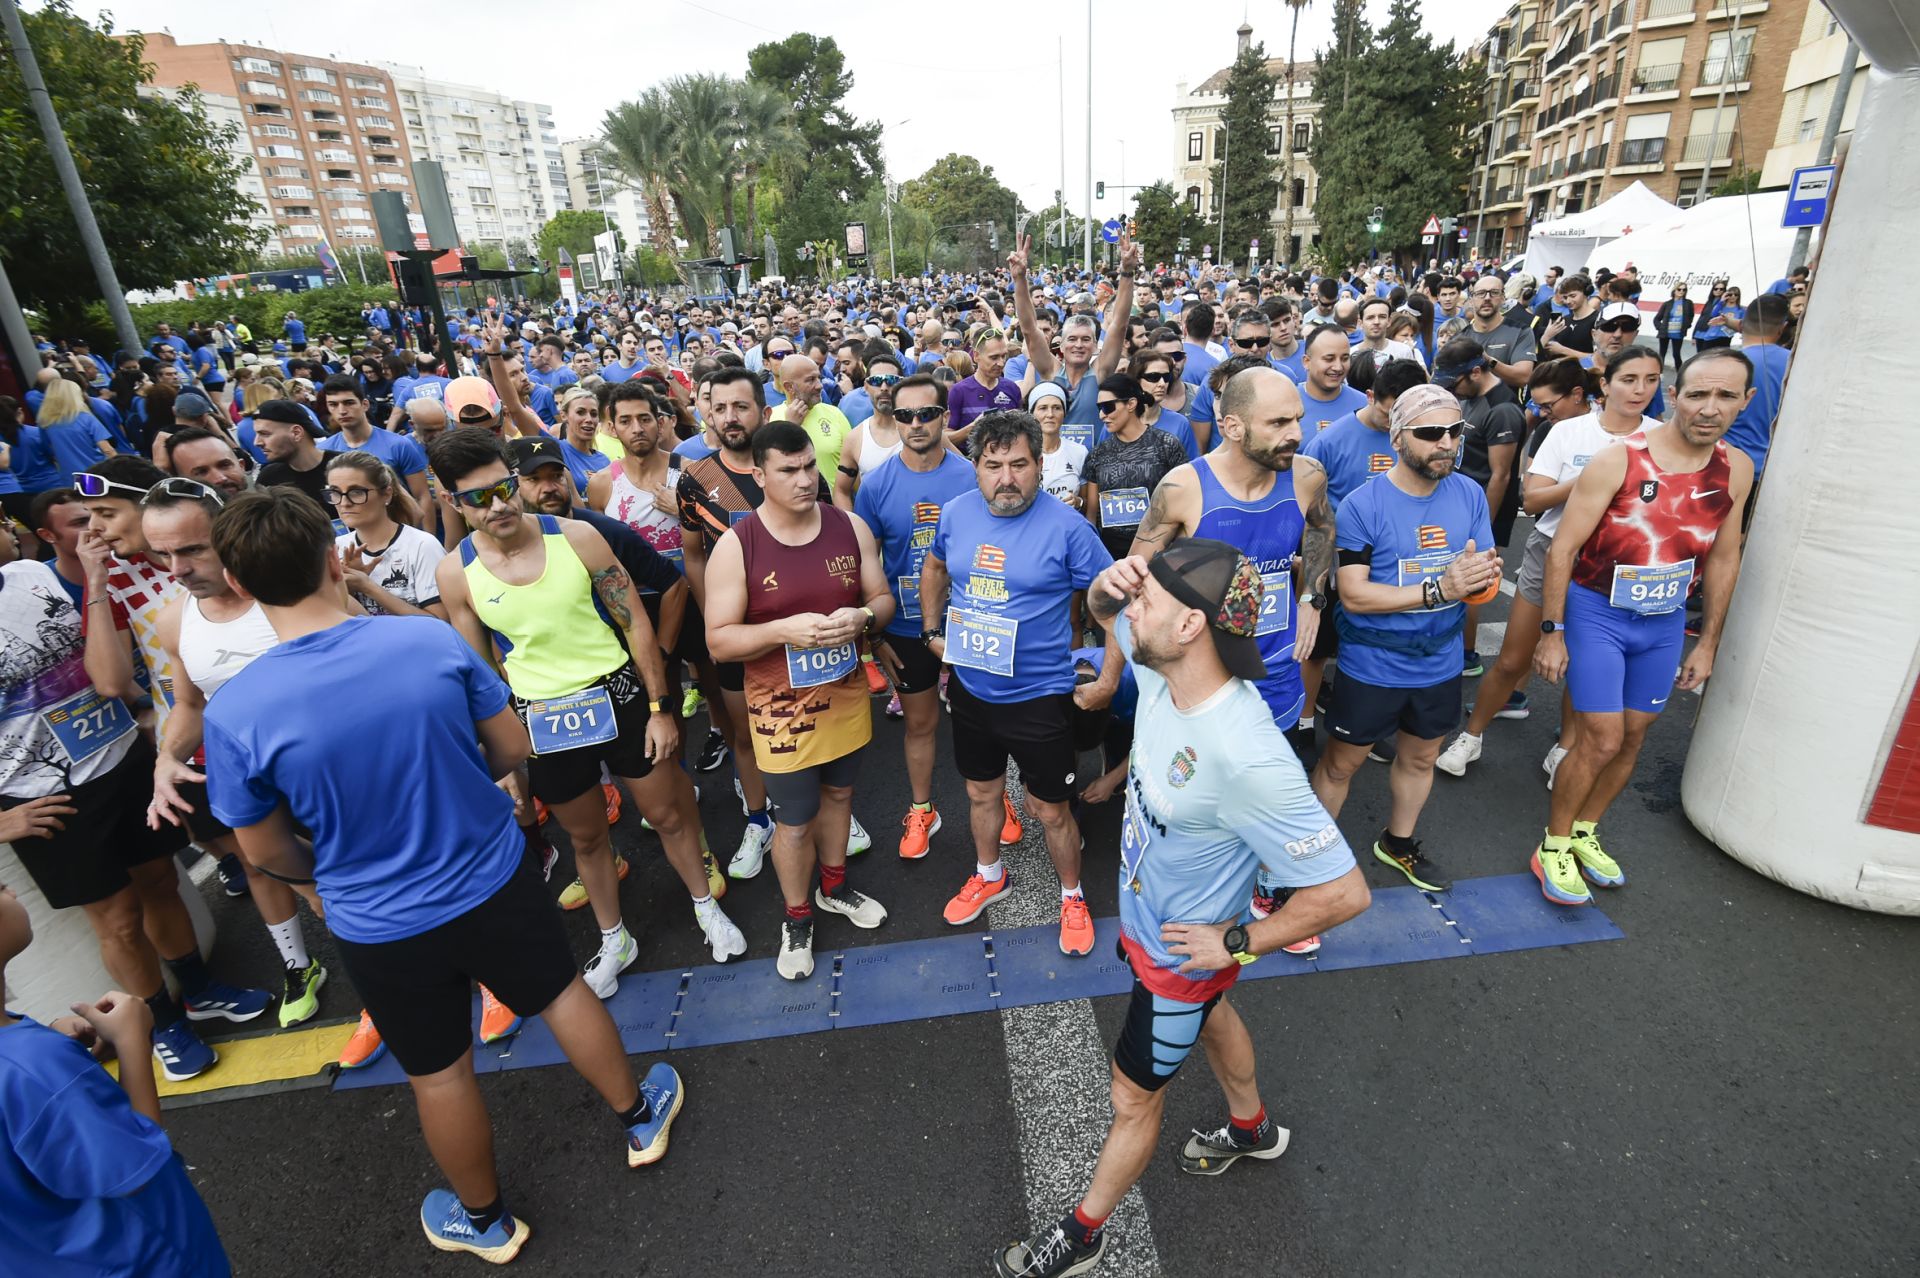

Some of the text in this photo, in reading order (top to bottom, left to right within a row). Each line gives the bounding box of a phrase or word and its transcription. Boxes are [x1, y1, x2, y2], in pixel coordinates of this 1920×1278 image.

[1568, 228, 1586, 237] Roja
[1657, 271, 1681, 290] Roja
[1683, 271, 1731, 290] Española
[420, 387, 438, 398] 124
[1105, 499, 1148, 516] 1164
[971, 585, 1009, 601] VALENCIA
[1630, 580, 1680, 601] 948
[958, 629, 1000, 657] 192
[796, 644, 852, 673] 1069
[72, 701, 116, 740] 277
[544, 708, 597, 735] 701
[856, 953, 889, 966] Feibot
[703, 972, 737, 985] Feibot
[941, 982, 977, 994] Feibot
[781, 1001, 817, 1014] Feibot
